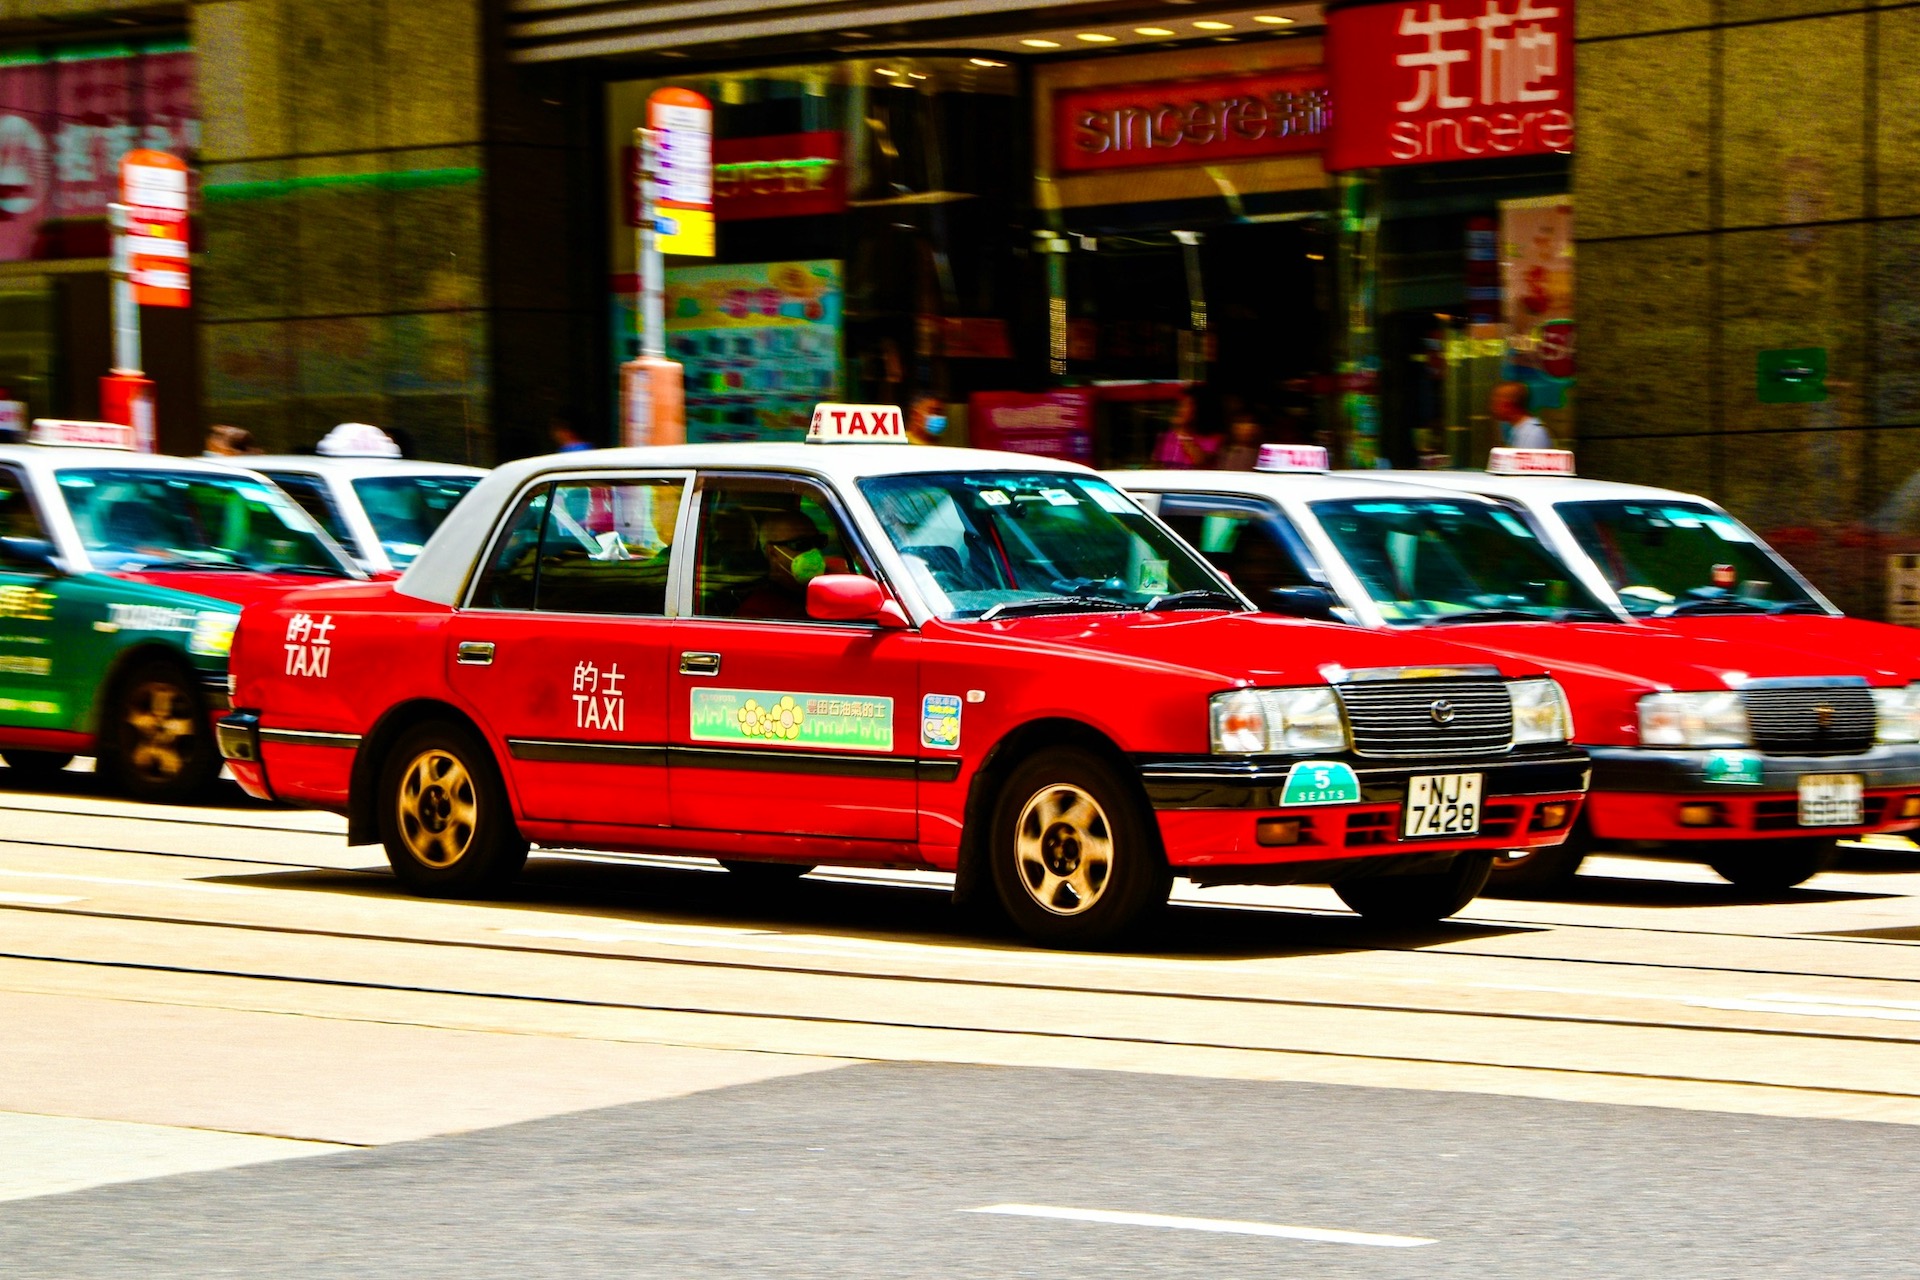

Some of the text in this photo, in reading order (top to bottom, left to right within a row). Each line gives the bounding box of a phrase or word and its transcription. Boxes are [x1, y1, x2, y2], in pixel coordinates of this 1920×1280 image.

[1396, 0, 1560, 112] 先施
[1073, 96, 1268, 154] sincere
[831, 411, 899, 436] TAXI
[286, 612, 336, 645] 的士
[284, 643, 331, 679] TAXI
[572, 660, 626, 696] 的士
[572, 694, 625, 732] TAXI
[1298, 789, 1345, 801] SEATS
[1313, 769, 1331, 790] 5
[1429, 776, 1462, 805] NJ
[1413, 803, 1474, 834] 7428
